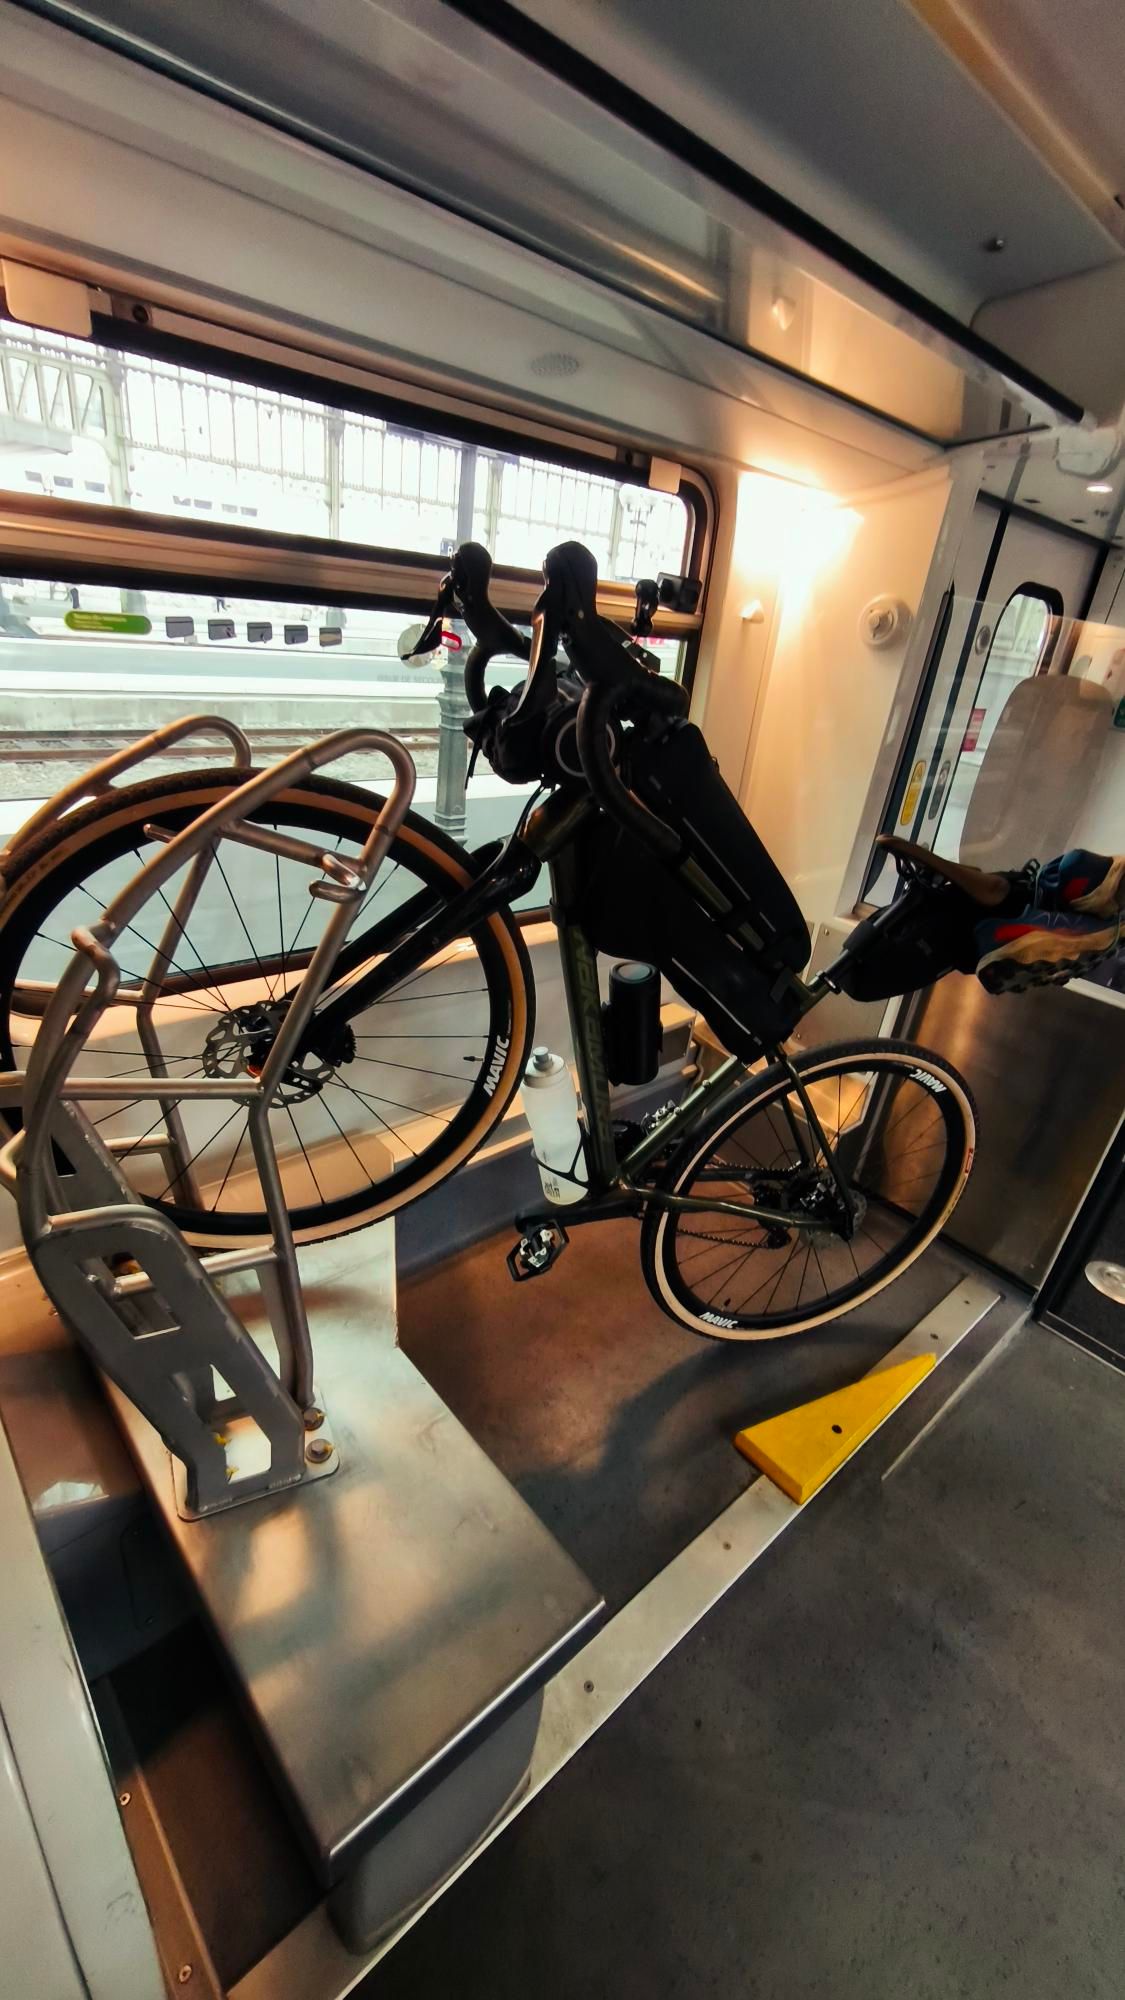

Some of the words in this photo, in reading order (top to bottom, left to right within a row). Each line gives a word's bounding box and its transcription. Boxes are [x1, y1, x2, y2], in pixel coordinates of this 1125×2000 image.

[483, 1035, 510, 1096] MAVIC
[909, 1069, 947, 1092] MAVIC
[699, 1311, 738, 1329] MAVIC
